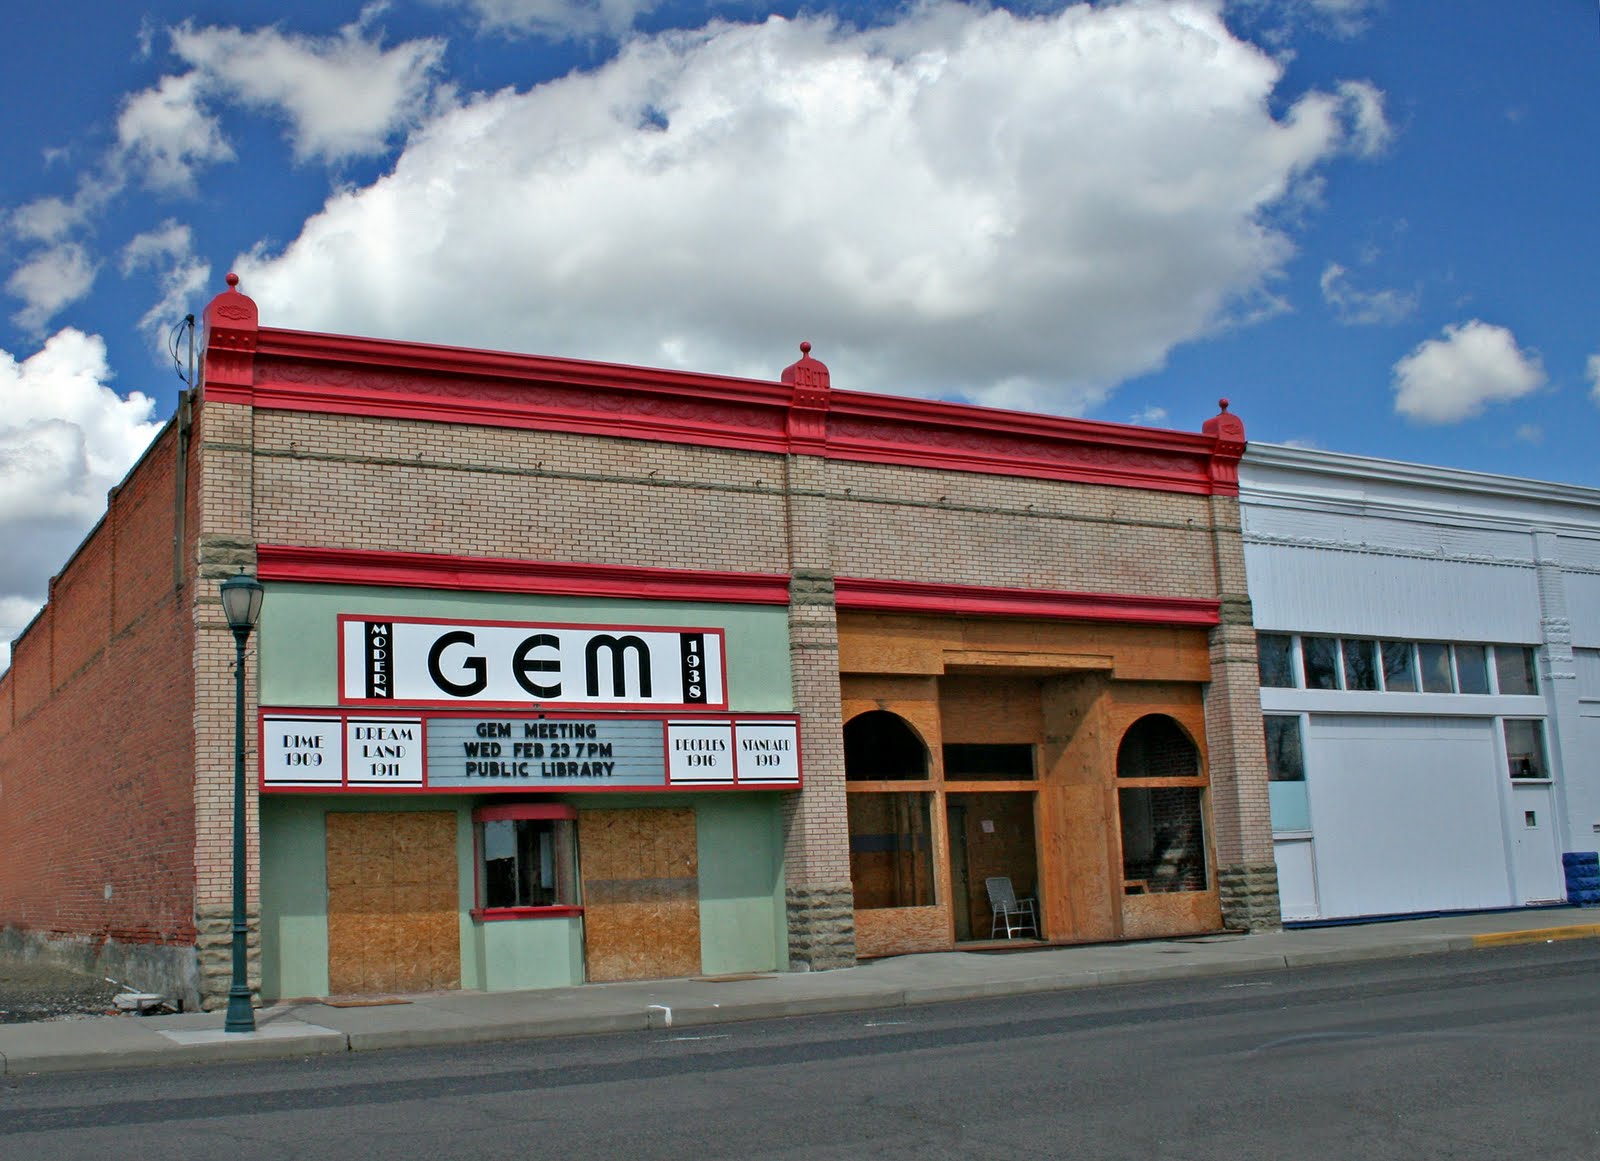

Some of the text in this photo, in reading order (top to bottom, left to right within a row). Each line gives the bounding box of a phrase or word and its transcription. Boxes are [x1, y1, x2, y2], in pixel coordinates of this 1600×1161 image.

[370, 623, 389, 698] MODERN
[427, 630, 652, 699] GEM
[686, 639, 702, 700] 1938
[355, 727, 414, 741] DREAM
[476, 722, 597, 738] GEM MEETING
[282, 734, 324, 749] DIME
[675, 739, 726, 751] PEOPLES
[742, 739, 792, 751] STANDARD
[362, 745, 407, 758] LAND
[463, 742, 501, 758] WED
[513, 742, 545, 758] FEB
[550, 743, 571, 758] 23
[284, 752, 323, 767] 1909
[686, 754, 717, 767] 1916
[754, 754, 781, 767] 1919
[370, 763, 400, 776] 1911
[465, 761, 615, 777] PUBLIC LIBRARY
